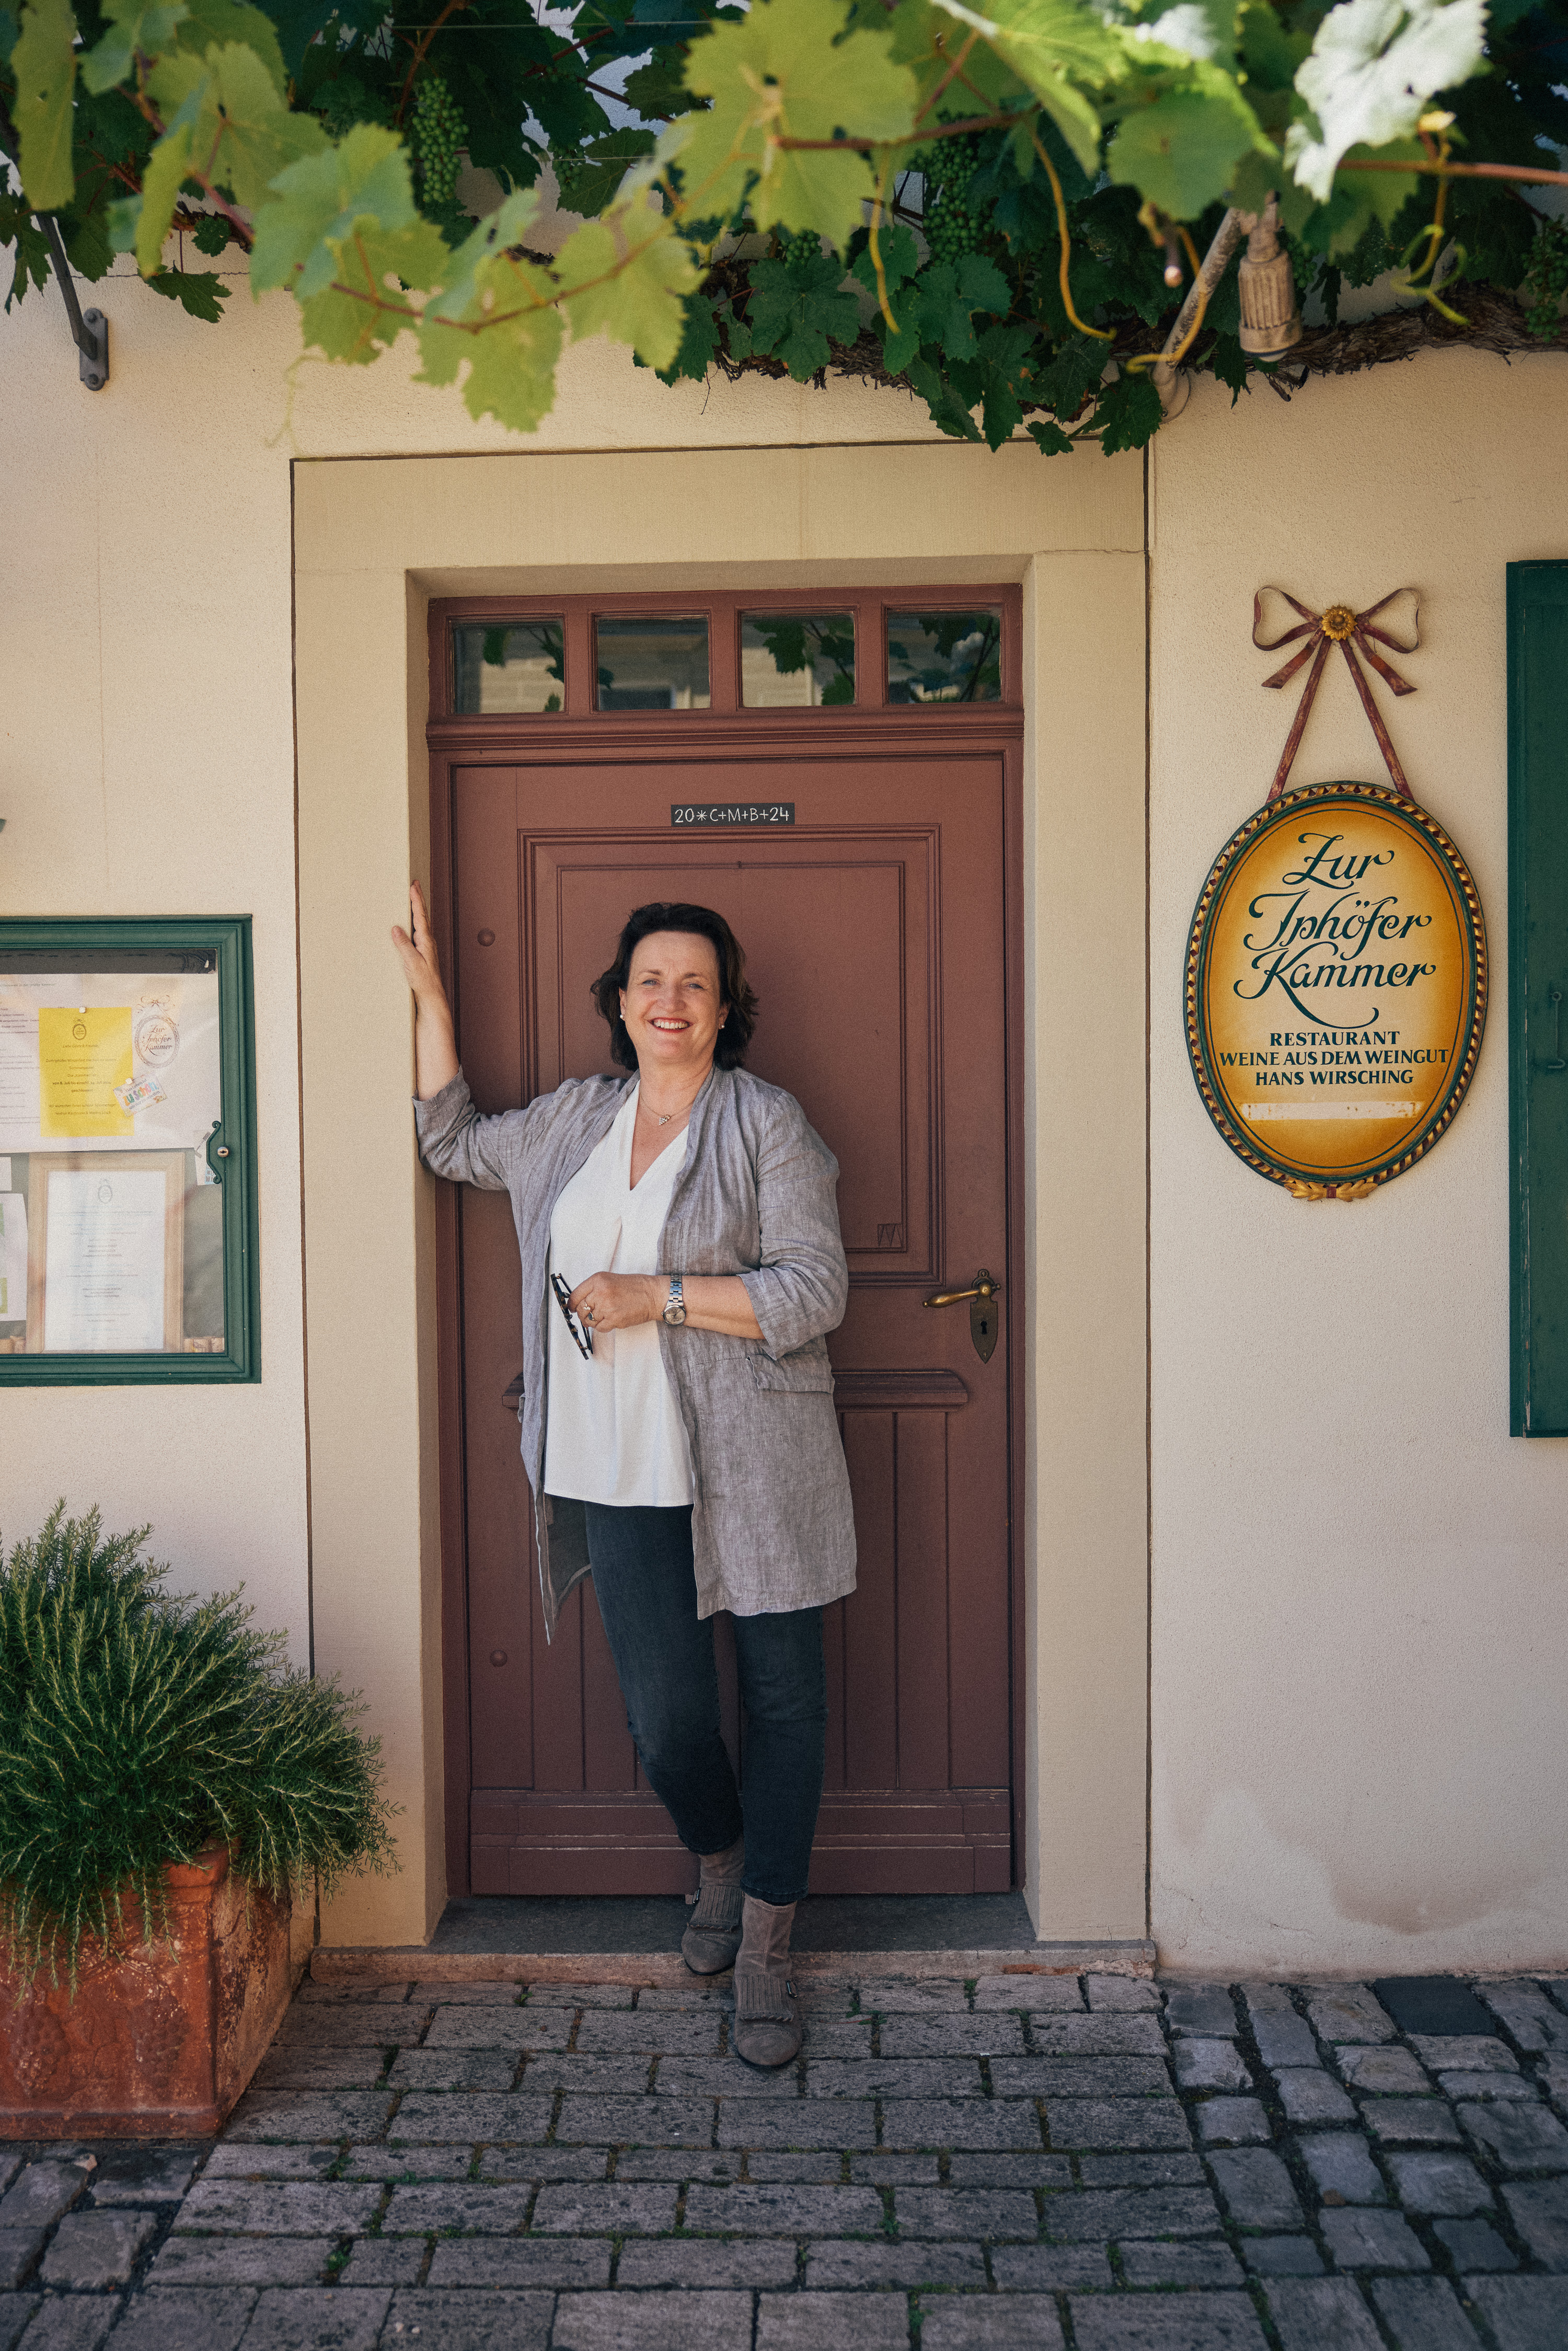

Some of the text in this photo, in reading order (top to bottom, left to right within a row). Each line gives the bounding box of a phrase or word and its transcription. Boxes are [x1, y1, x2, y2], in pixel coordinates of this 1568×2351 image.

[1283, 833, 1394, 890] Zur
[1233, 941, 1436, 1029] Kammer
[1270, 1031, 1400, 1046] RESTAURANT
[1220, 1050, 1449, 1066] WEINE AUS DEM WEINGUT
[1255, 1070, 1413, 1086] HANS WIRSCHING
